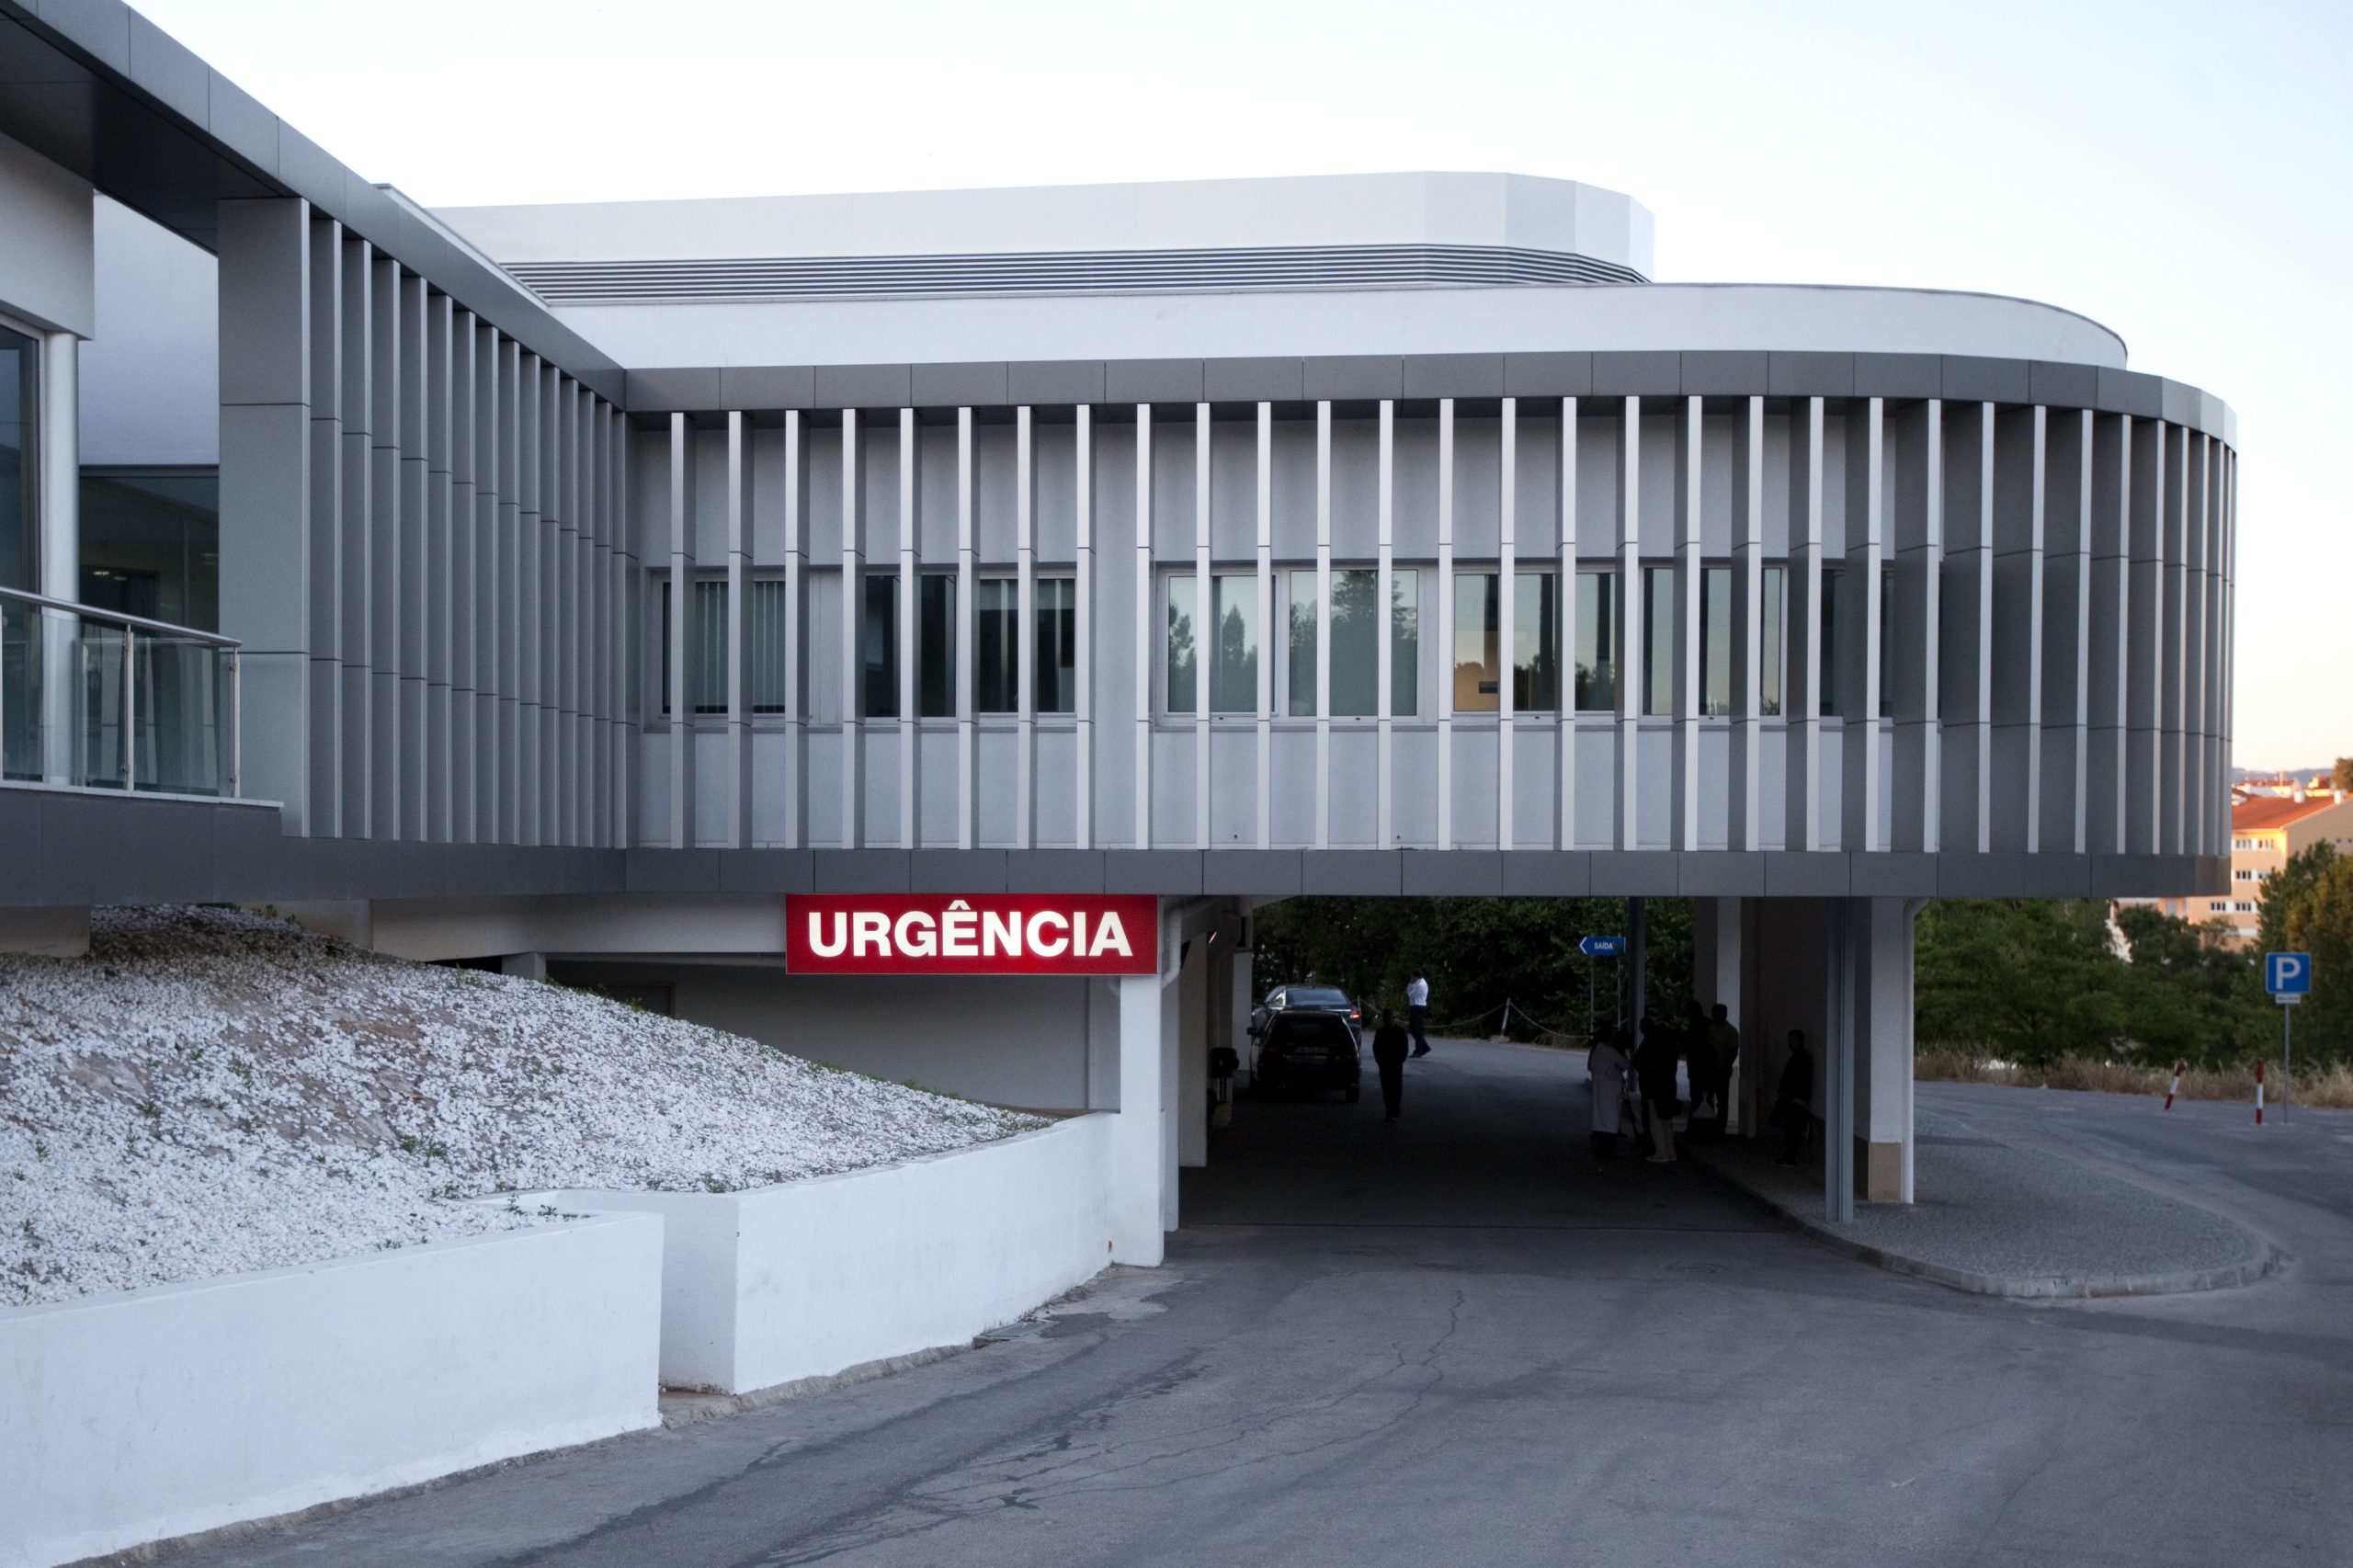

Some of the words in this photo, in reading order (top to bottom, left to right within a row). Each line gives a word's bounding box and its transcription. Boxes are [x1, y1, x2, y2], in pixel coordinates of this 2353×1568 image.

[808, 899, 1133, 958] URGÊNCIA
[1594, 940, 1613, 949] SAÍDA
[2276, 957, 2302, 990] P
